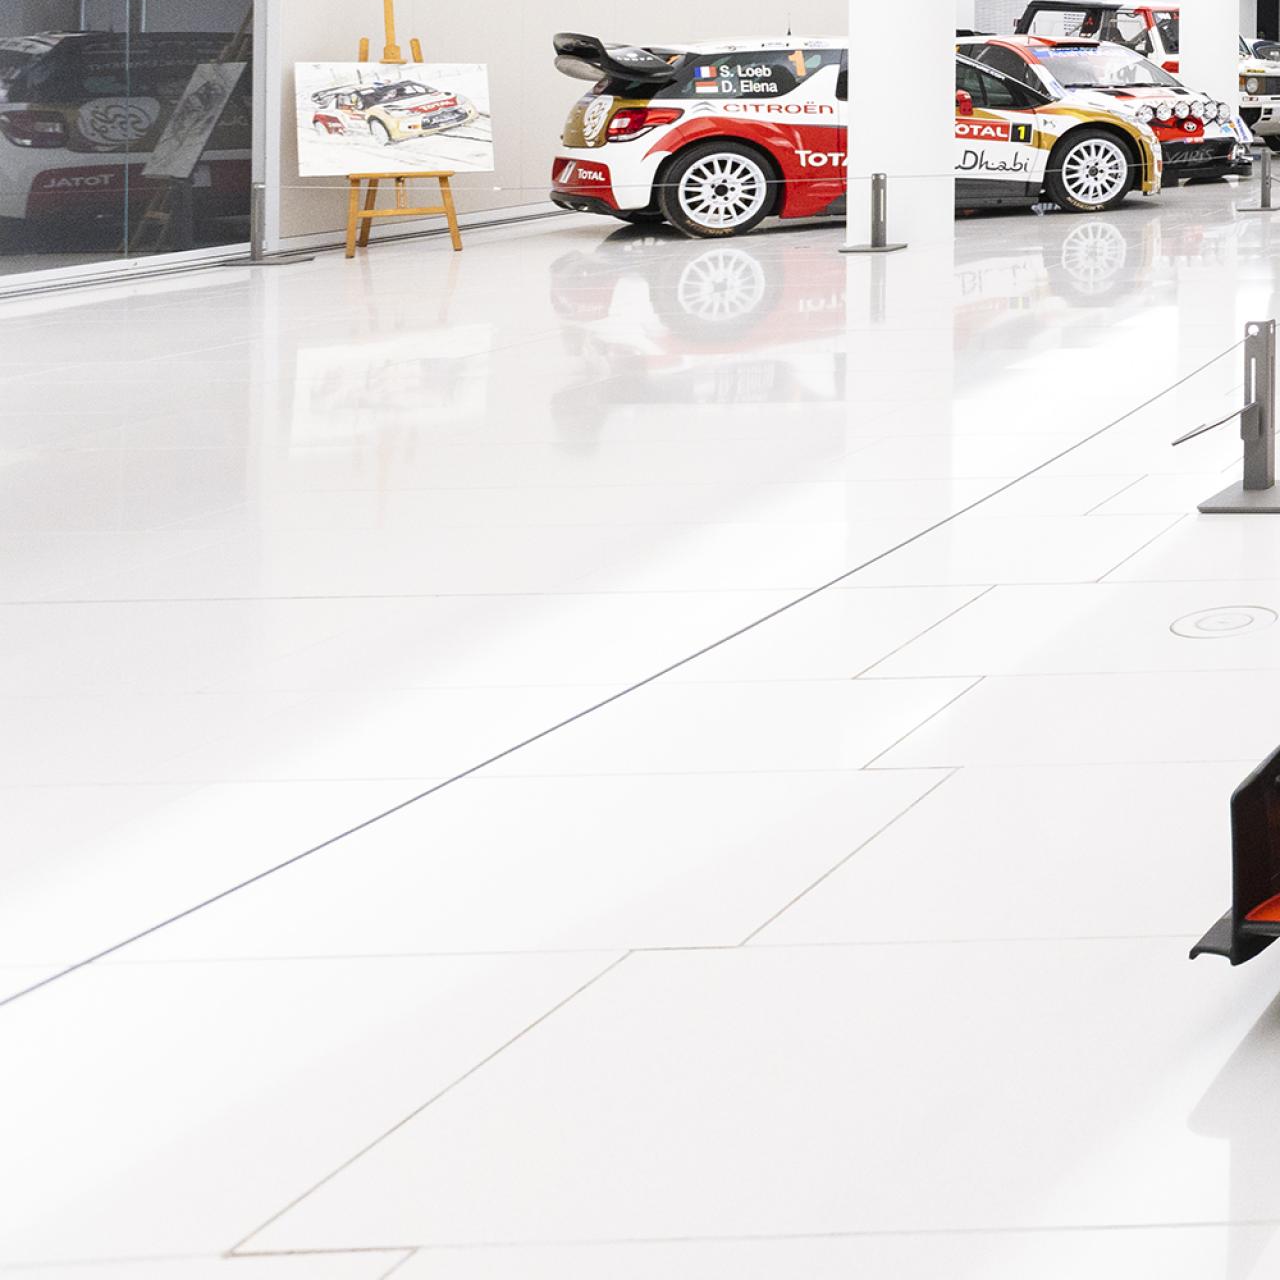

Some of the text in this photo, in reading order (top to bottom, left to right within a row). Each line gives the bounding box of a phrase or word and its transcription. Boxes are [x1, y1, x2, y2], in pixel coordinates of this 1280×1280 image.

[719, 65, 772, 78] S. Loeb
[721, 80, 778, 93] D. Elena
[955, 122, 1008, 138] OTAL
[1017, 125, 1026, 139] 1
[794, 149, 848, 168] TOT
[955, 150, 1030, 173] Dhabi
[577, 167, 606, 182] TOTAL
